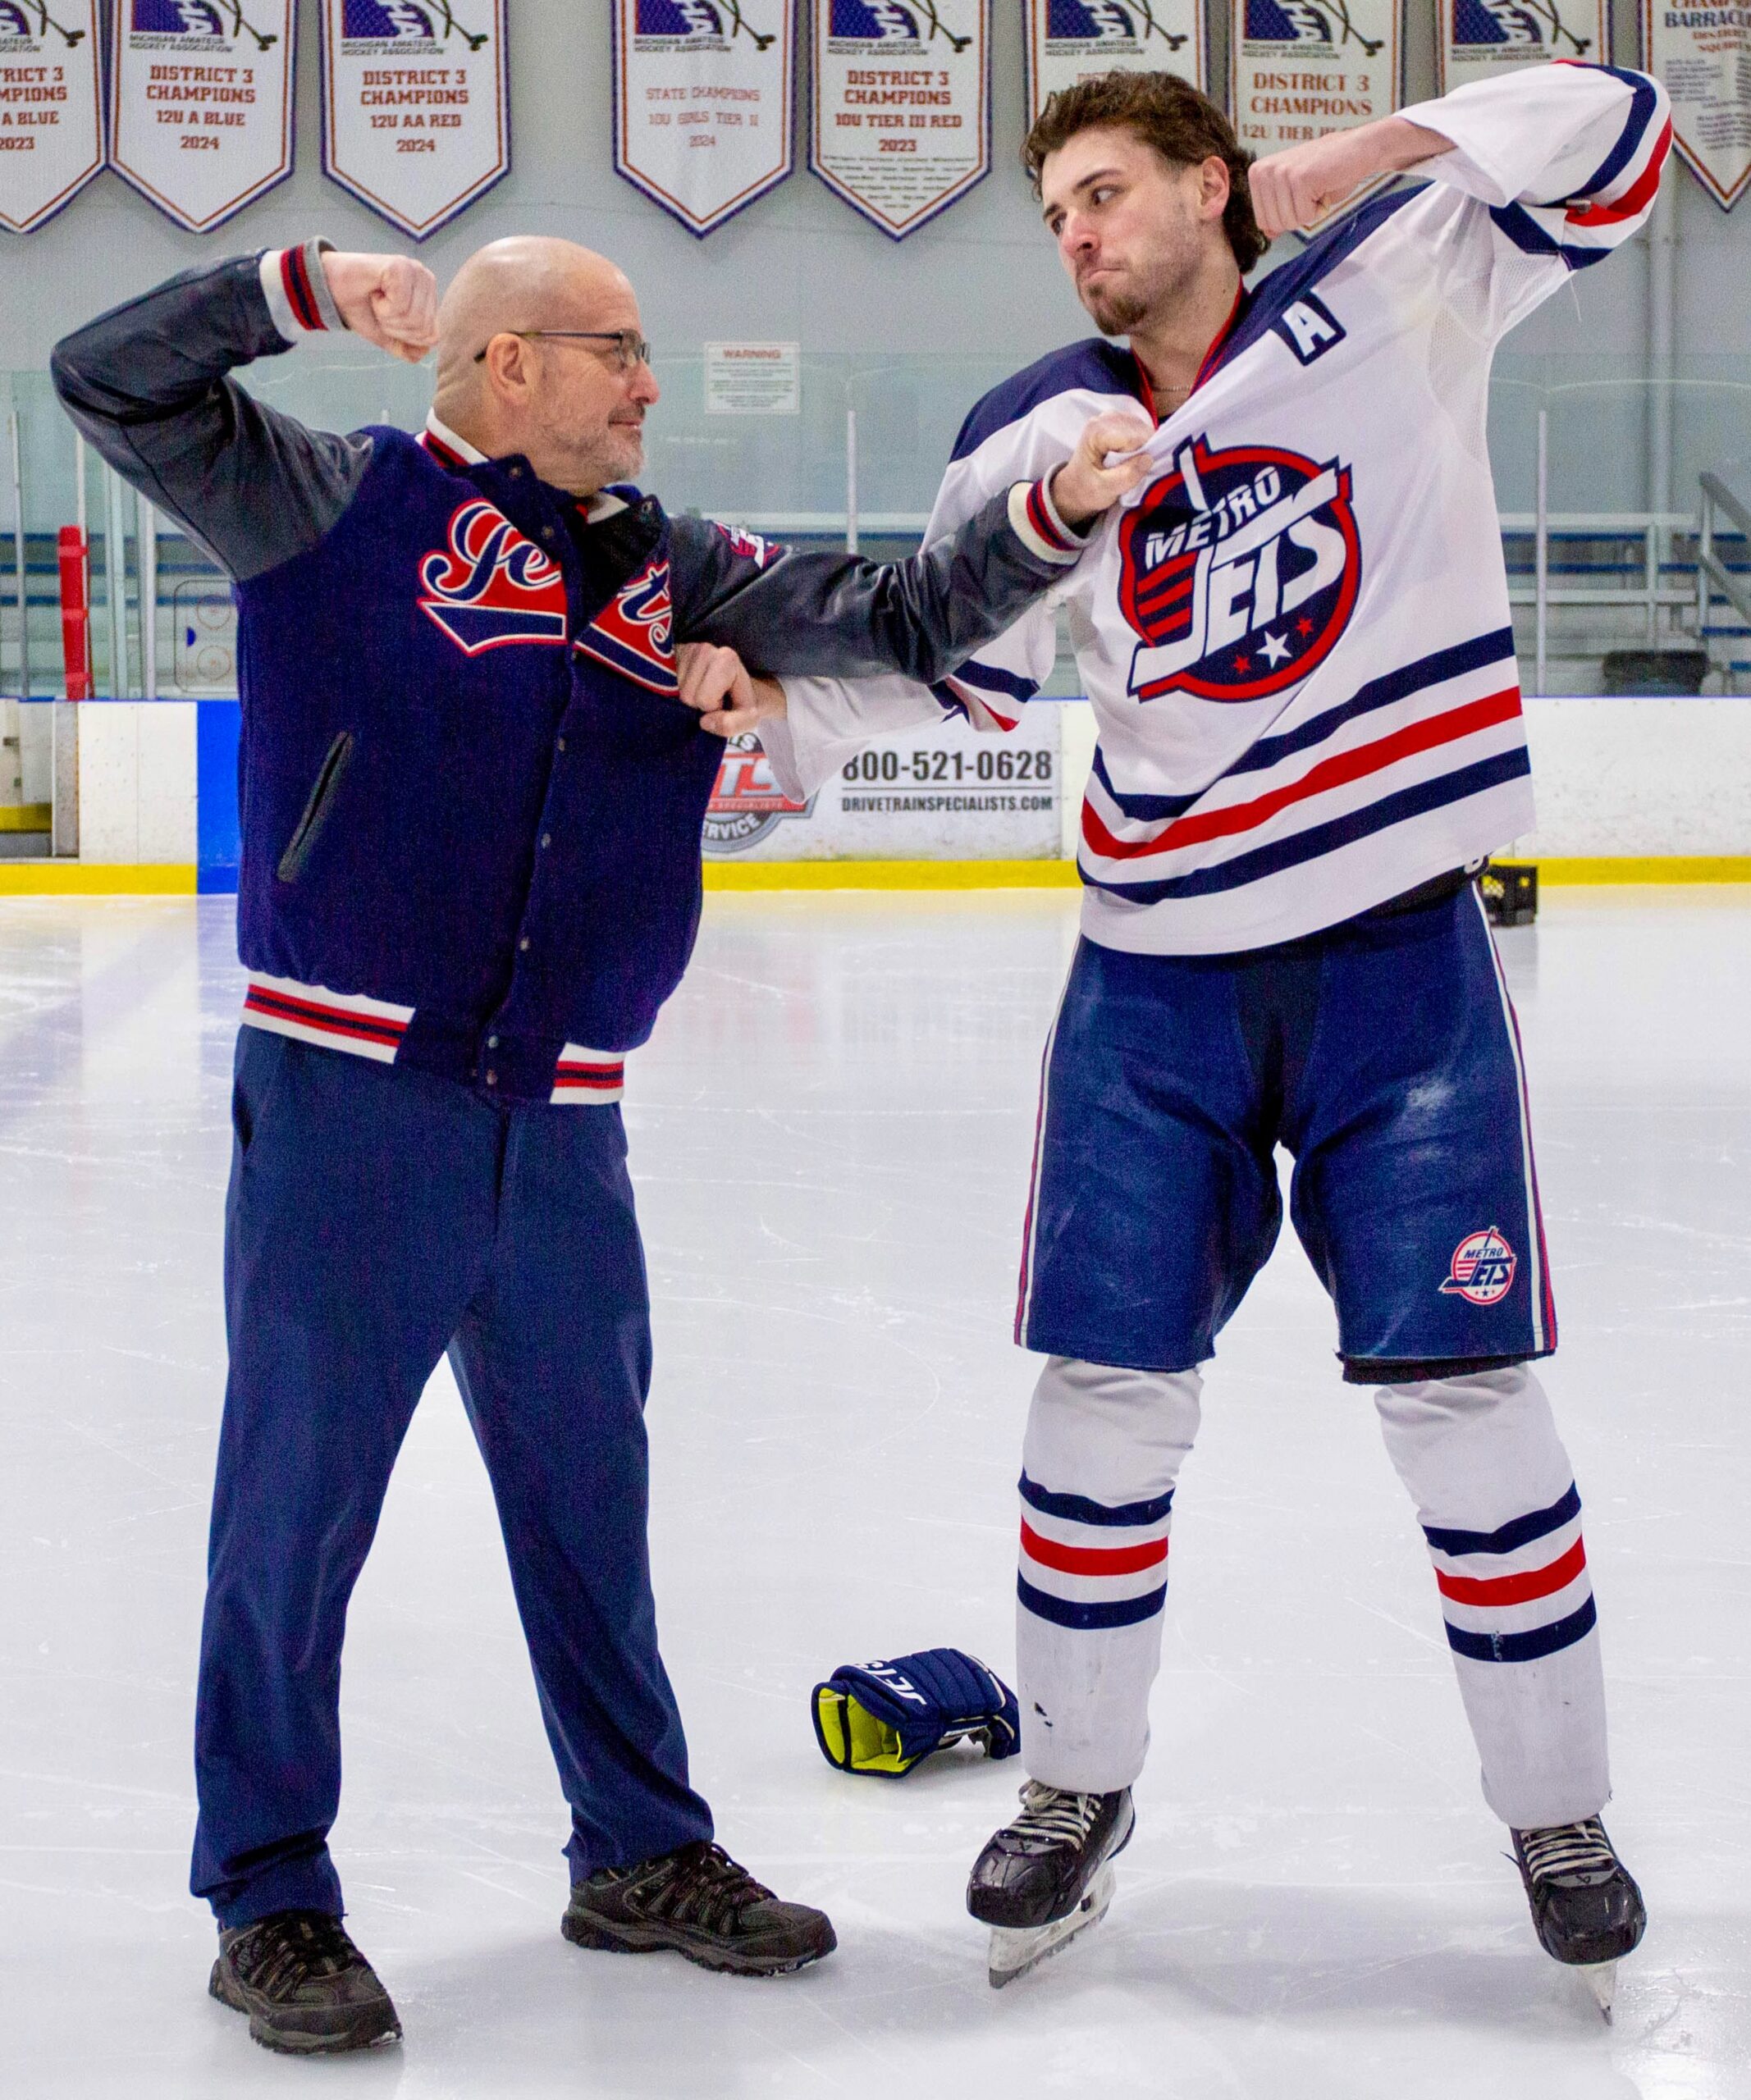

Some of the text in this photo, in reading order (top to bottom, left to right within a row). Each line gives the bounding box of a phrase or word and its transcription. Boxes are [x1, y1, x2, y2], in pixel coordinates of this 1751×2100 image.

[53, 66, 63, 81] 3
[149, 65, 254, 84] DISTRICT 3
[363, 69, 466, 85] DISTRICT 3
[848, 70, 949, 86] DISTRICT 3
[1253, 71, 1370, 93] DISTRICT 3
[146, 84, 256, 103] CHAMPIONS
[360, 89, 469, 105] CHAMPIONS
[647, 86, 760, 101] STATE CHAMPIONS
[844, 89, 952, 105] CHAMPIONS
[1250, 95, 1373, 116] CHAMPIONS
[2, 111, 59, 125] A BLUE
[157, 110, 245, 126] 12U A BLUE
[370, 114, 462, 128] 12U AA RED
[715, 112, 743, 125] TIER
[835, 112, 962, 128] 10U TIER III RED
[1278, 125, 1314, 140] TIER
[181, 135, 220, 149] 2024
[396, 139, 435, 153] 2024
[879, 139, 917, 153] 2023
[1282, 300, 1336, 357] A
[723, 349, 781, 359] WARNING
[1144, 465, 1282, 571] METRO
[1131, 467, 1346, 691] JETS
[842, 750, 1053, 781] 800-521-0628
[842, 796, 1053, 812] DRIVETRAINSPECIALISTS.COM
[1464, 1247, 1504, 1259] METRO
[1442, 1256, 1515, 1287] JETS
